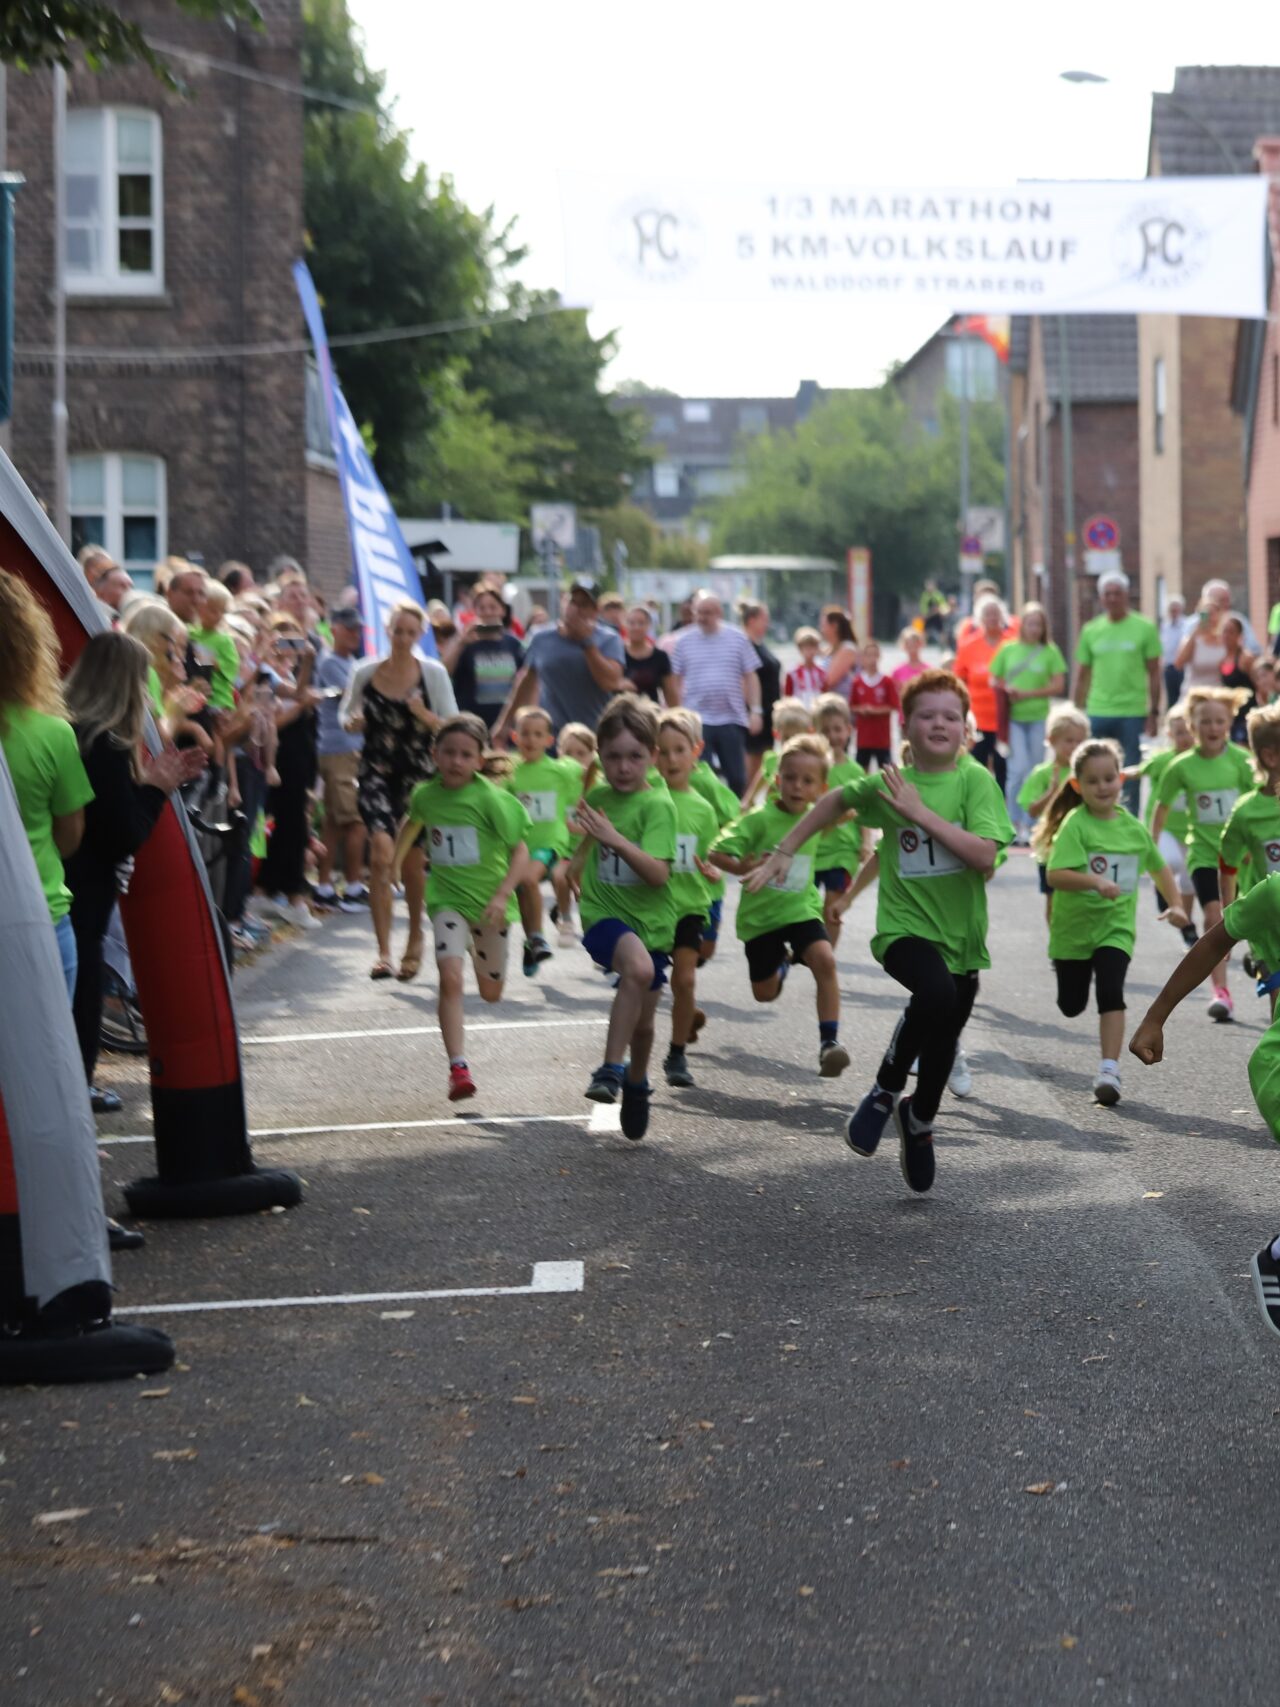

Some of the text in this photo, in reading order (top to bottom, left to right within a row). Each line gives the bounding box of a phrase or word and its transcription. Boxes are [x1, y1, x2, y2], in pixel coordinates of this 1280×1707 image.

[828, 195, 1053, 223] MARATHON
[736, 233, 1078, 264] 5 KM-VOLKSLAUF
[446, 833, 455, 858] 1
[678, 843, 687, 865] 1
[922, 837, 935, 866] 1
[611, 851, 620, 877] 1
[1111, 863, 1119, 884] 1
